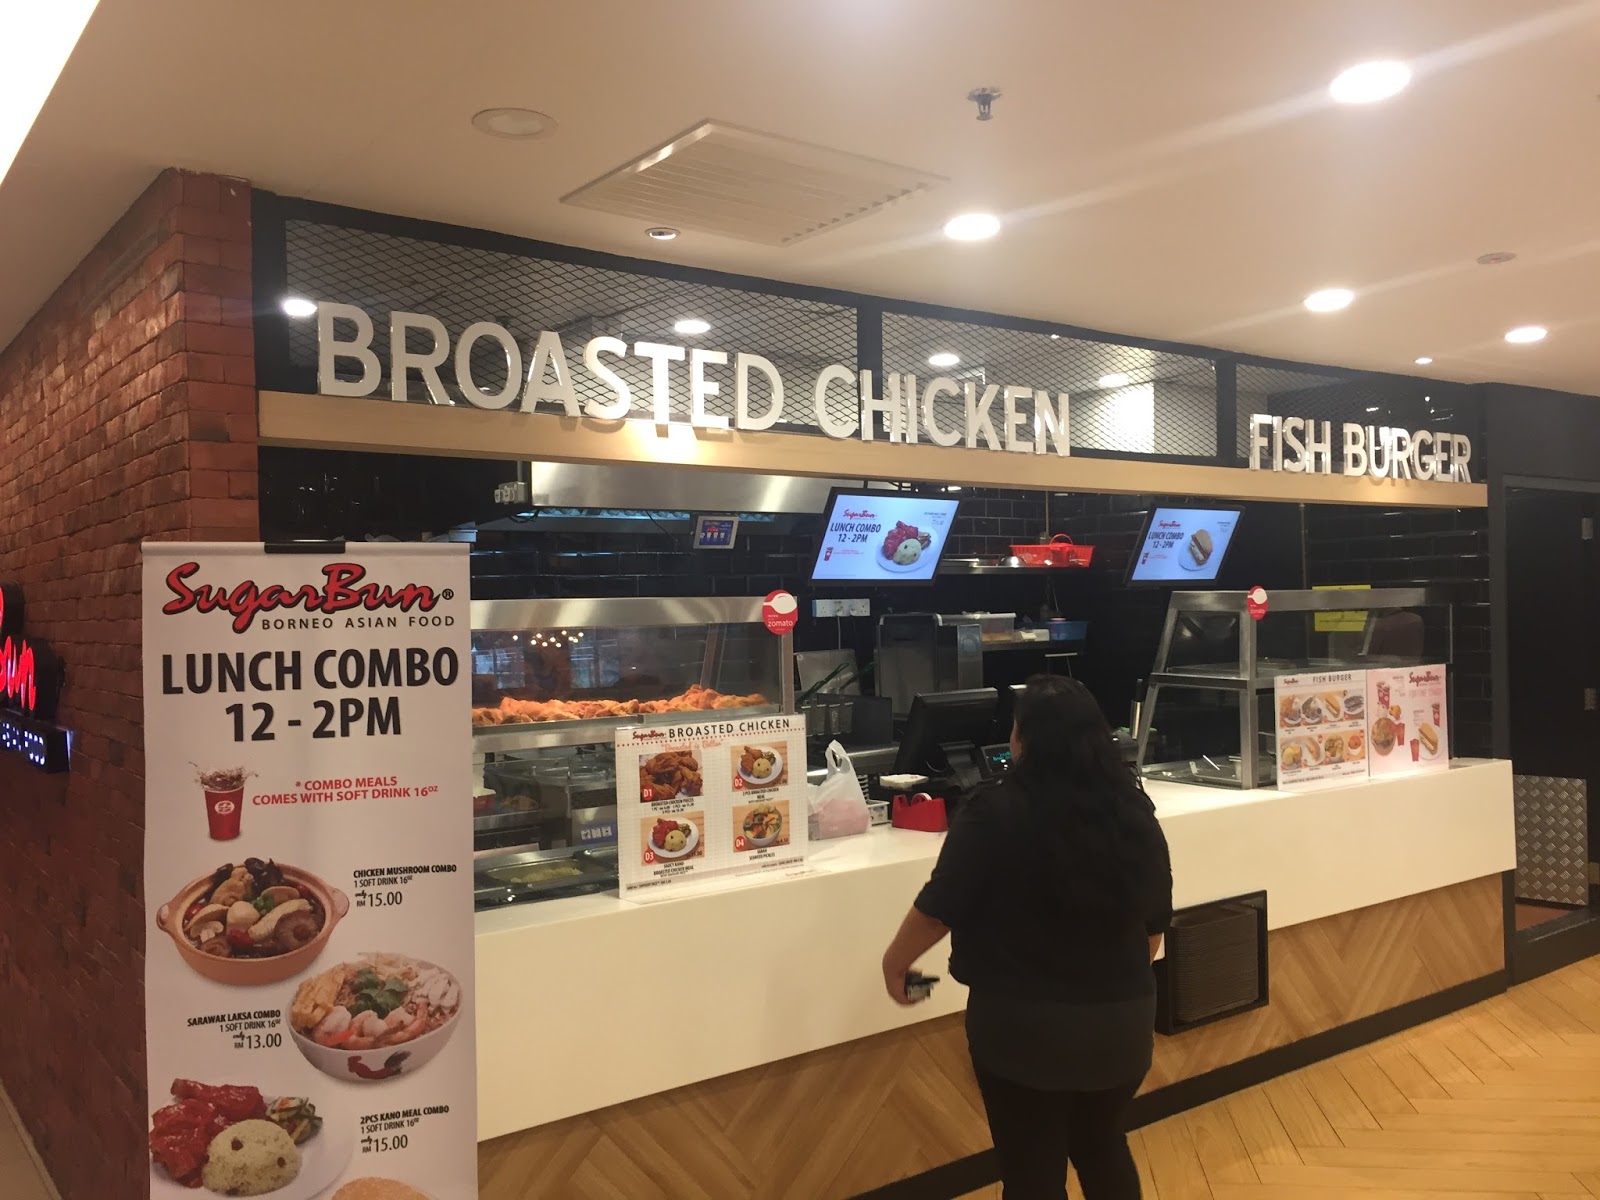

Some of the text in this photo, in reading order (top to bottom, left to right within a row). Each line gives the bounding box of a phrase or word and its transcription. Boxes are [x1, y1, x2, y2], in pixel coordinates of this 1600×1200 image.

[317, 301, 1071, 457] BROASTED CHICKEN
[1250, 413, 1472, 484] FISH BURGER
[830, 522, 881, 533] LUNCH COMBO
[838, 533, 847, 543] 12
[851, 533, 868, 543] 2PM
[162, 562, 441, 634] SugarBun
[261, 615, 455, 630] BORNEO ASIAN FOOD
[162, 647, 459, 694] LUNCH COMBO
[225, 696, 402, 742] 12 - 2PM
[668, 723, 733, 739] BROASTED
[739, 719, 790, 732] CHICKEN
[304, 776, 398, 791] COMBO MEALS
[252, 793, 298, 806] COMES
[300, 792, 333, 803] WITH
[336, 790, 369, 802] SOFT
[372, 788, 411, 799] DRINK
[353, 864, 457, 878] CHICKEN MUSHROOM COMBO
[359, 878, 376, 888] SOFT
[377, 877, 398, 886] DRINK
[368, 891, 403, 907] 15.00
[187, 1009, 281, 1027] SARAWAK LAKSA COMBO
[225, 1022, 242, 1032] SOFT
[244, 1020, 266, 1030] DRINK
[246, 1033, 282, 1049] 13.00
[360, 1104, 449, 1125] 2PCS KANO MEAL COMBO
[366, 1123, 382, 1133] SOFT
[384, 1121, 405, 1131] DRINK
[373, 1134, 408, 1152] 15.00
